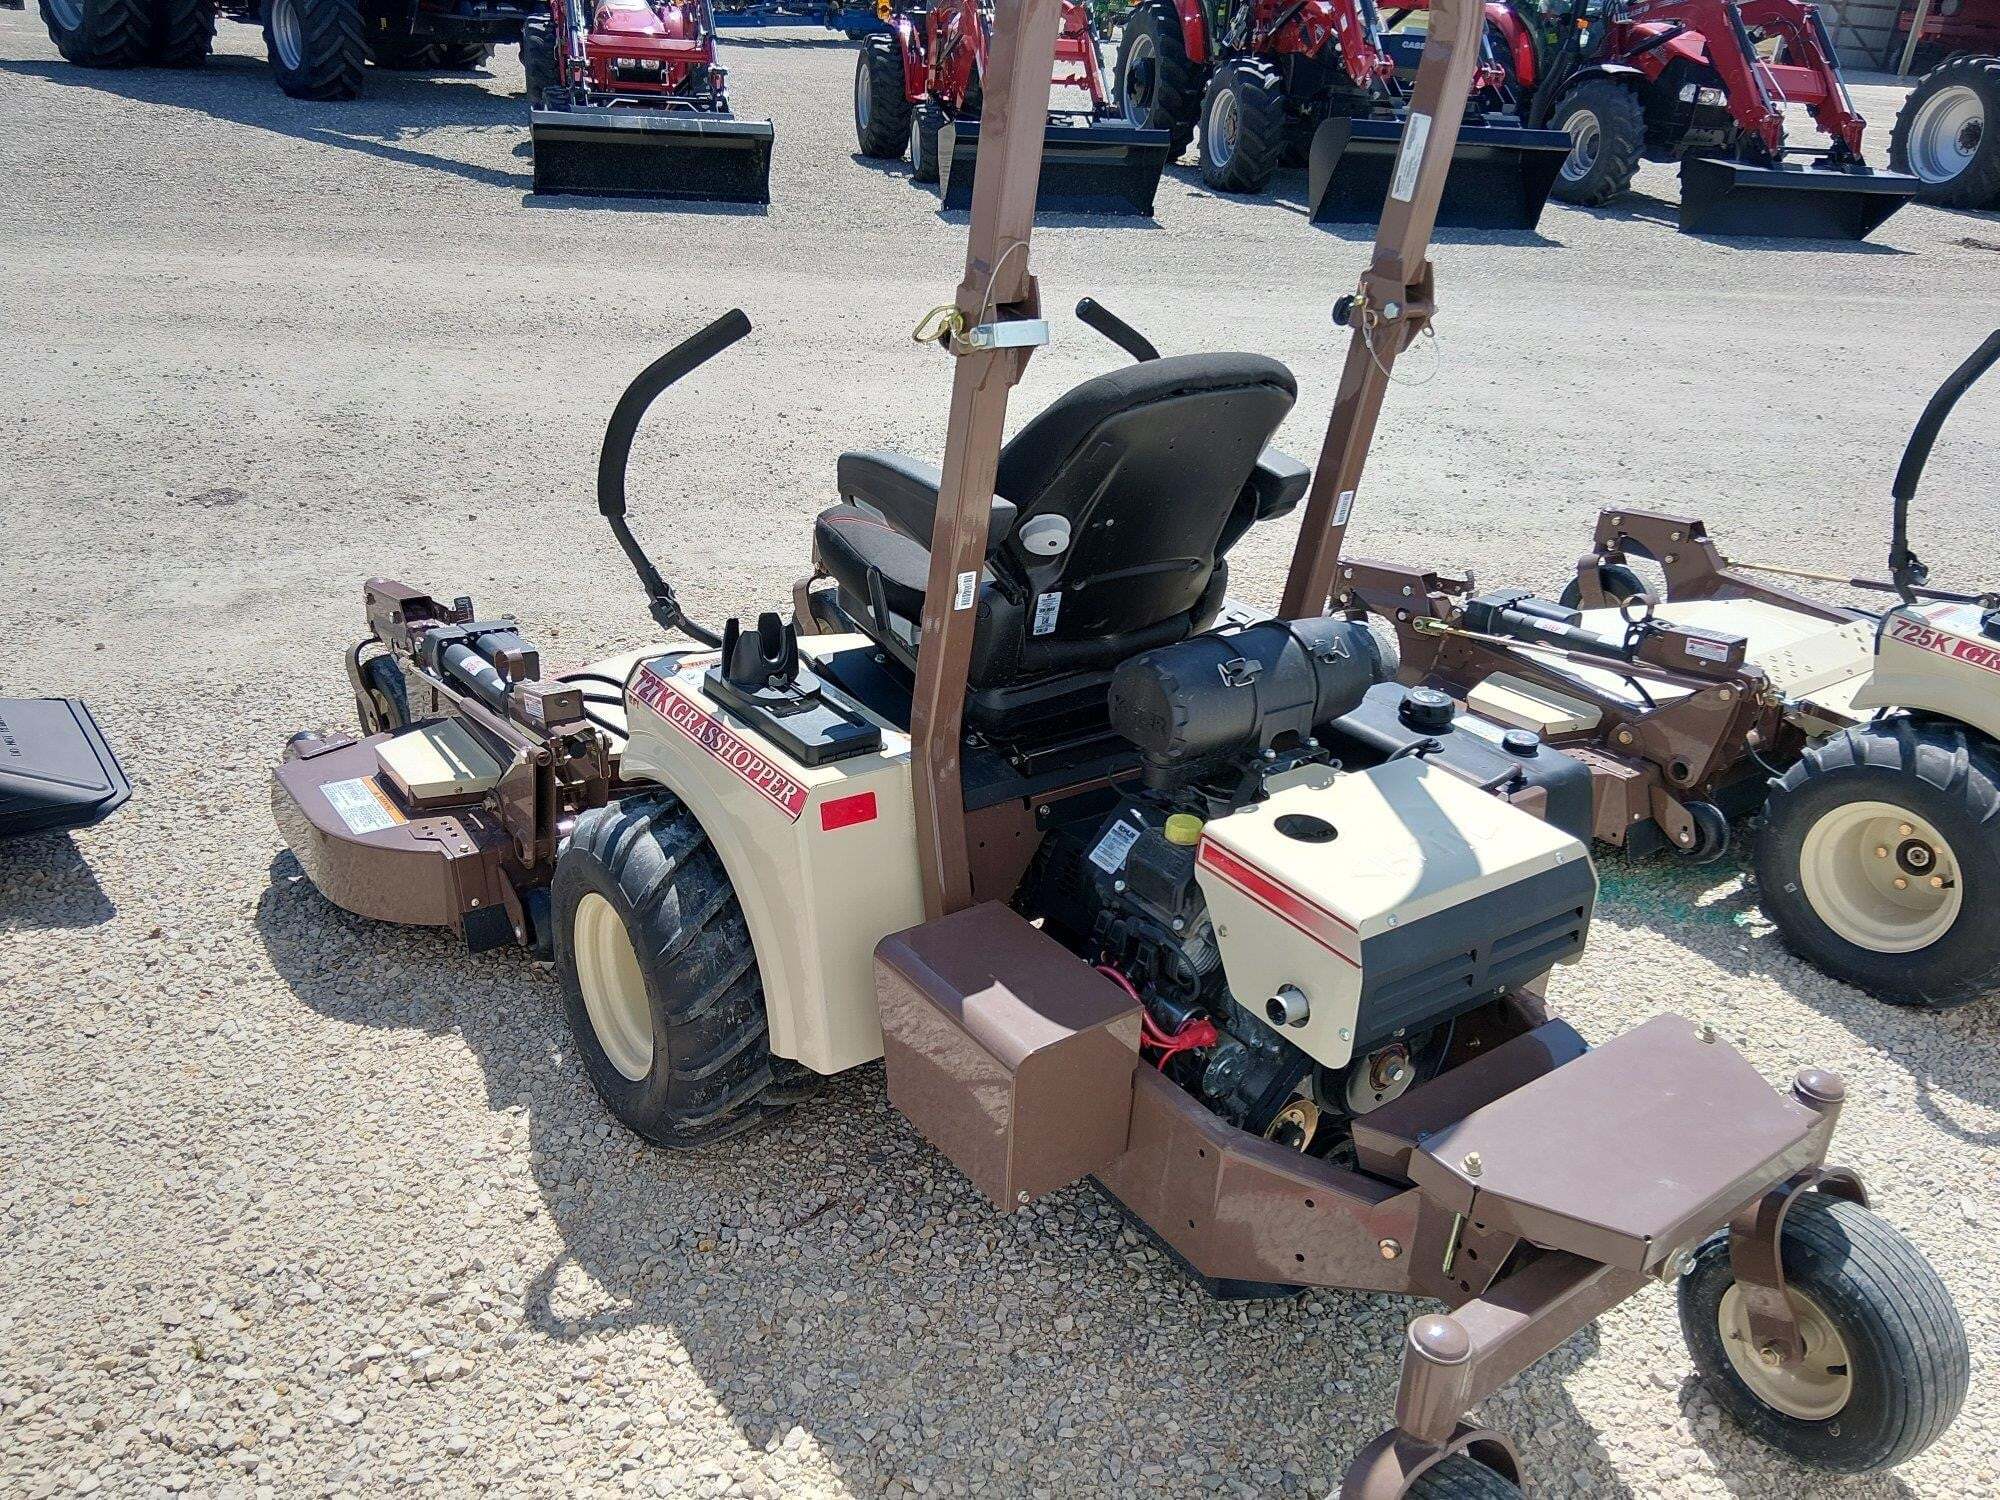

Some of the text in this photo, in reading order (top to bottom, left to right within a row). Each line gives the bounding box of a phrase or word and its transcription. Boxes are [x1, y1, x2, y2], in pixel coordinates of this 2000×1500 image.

[1892, 620, 1953, 652] 725K
[632, 669, 798, 806] 727K GRASSHOPPER
